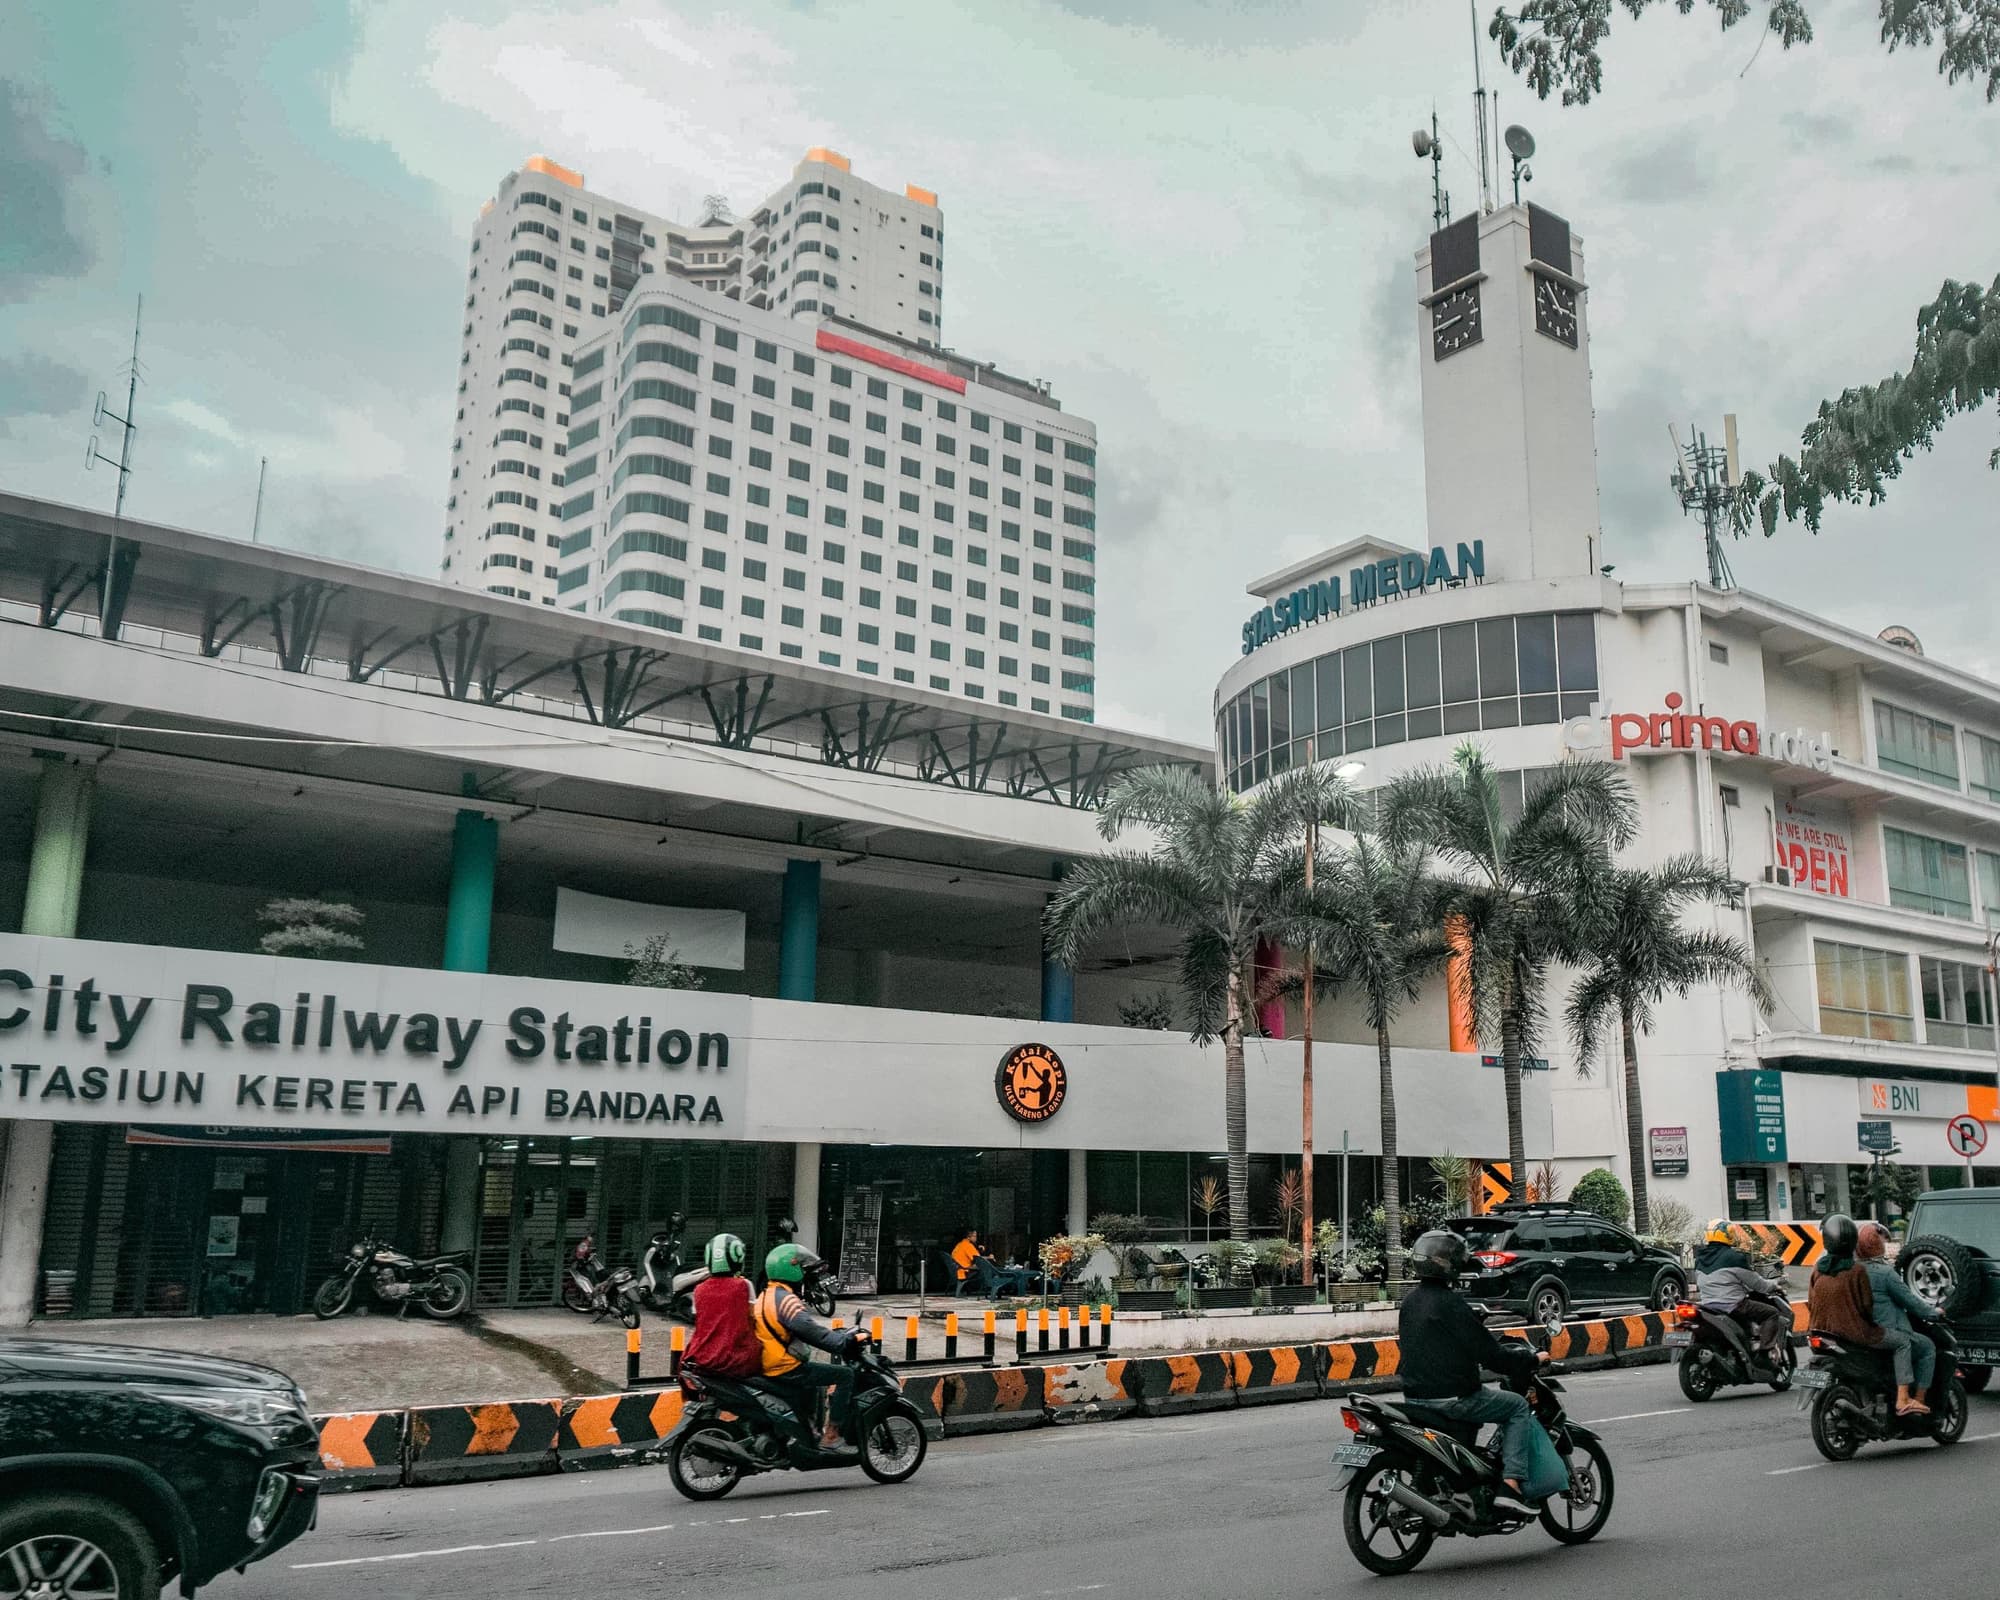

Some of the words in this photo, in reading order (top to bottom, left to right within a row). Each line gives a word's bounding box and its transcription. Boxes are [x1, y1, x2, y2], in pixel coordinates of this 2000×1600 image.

[1241, 575, 1341, 656] STASIUN
[1351, 539, 1485, 606] MEDAN
[1785, 822, 1800, 840] WE
[1803, 827, 1822, 845] ARE
[1824, 832, 1848, 852] STILL
[0, 968, 154, 1053] City
[181, 983, 483, 1070] Railway
[504, 1006, 729, 1068] Station
[1006, 1047, 1041, 1074] Kedai
[1044, 1050, 1065, 1085] Kopi
[0, 1063, 205, 1104] TASIUN
[236, 1073, 425, 1113] KERETA
[447, 1085, 520, 1116] API
[544, 1088, 725, 1123] BANDARA
[1004, 1084, 1017, 1105] ULEE
[1014, 1103, 1042, 1119] KARENG
[1048, 1091, 1064, 1112] GAYO
[1891, 1085, 1920, 1112] BNI
